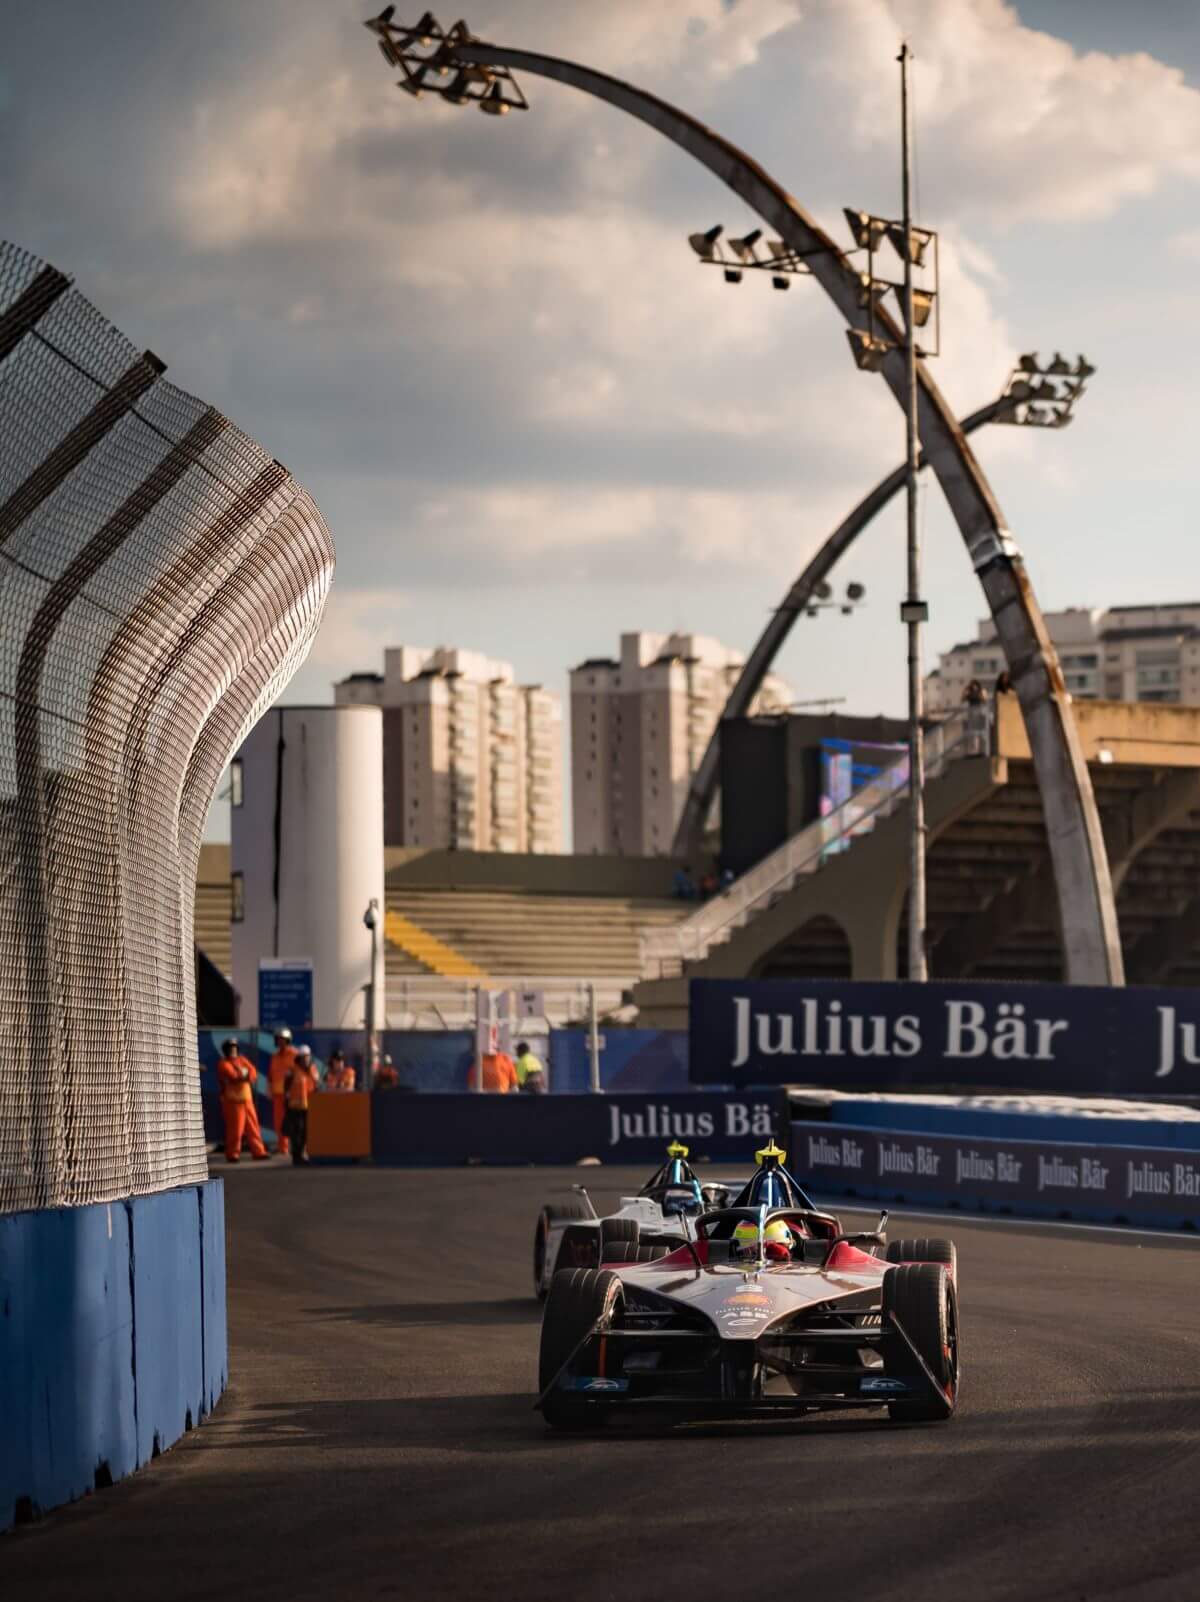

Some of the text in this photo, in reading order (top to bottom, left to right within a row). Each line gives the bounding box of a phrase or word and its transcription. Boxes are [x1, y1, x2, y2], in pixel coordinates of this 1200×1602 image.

[732, 997, 1069, 1067] Julius Bär
[610, 1103, 779, 1145] Julius Bä
[808, 1135, 864, 1169] Julius Bär
[878, 1142, 941, 1177] Julius Bär
[956, 1148, 1023, 1184] Julius Bär
[1037, 1154, 1110, 1191] Julius Bär
[1127, 1160, 1171, 1198] Julius
